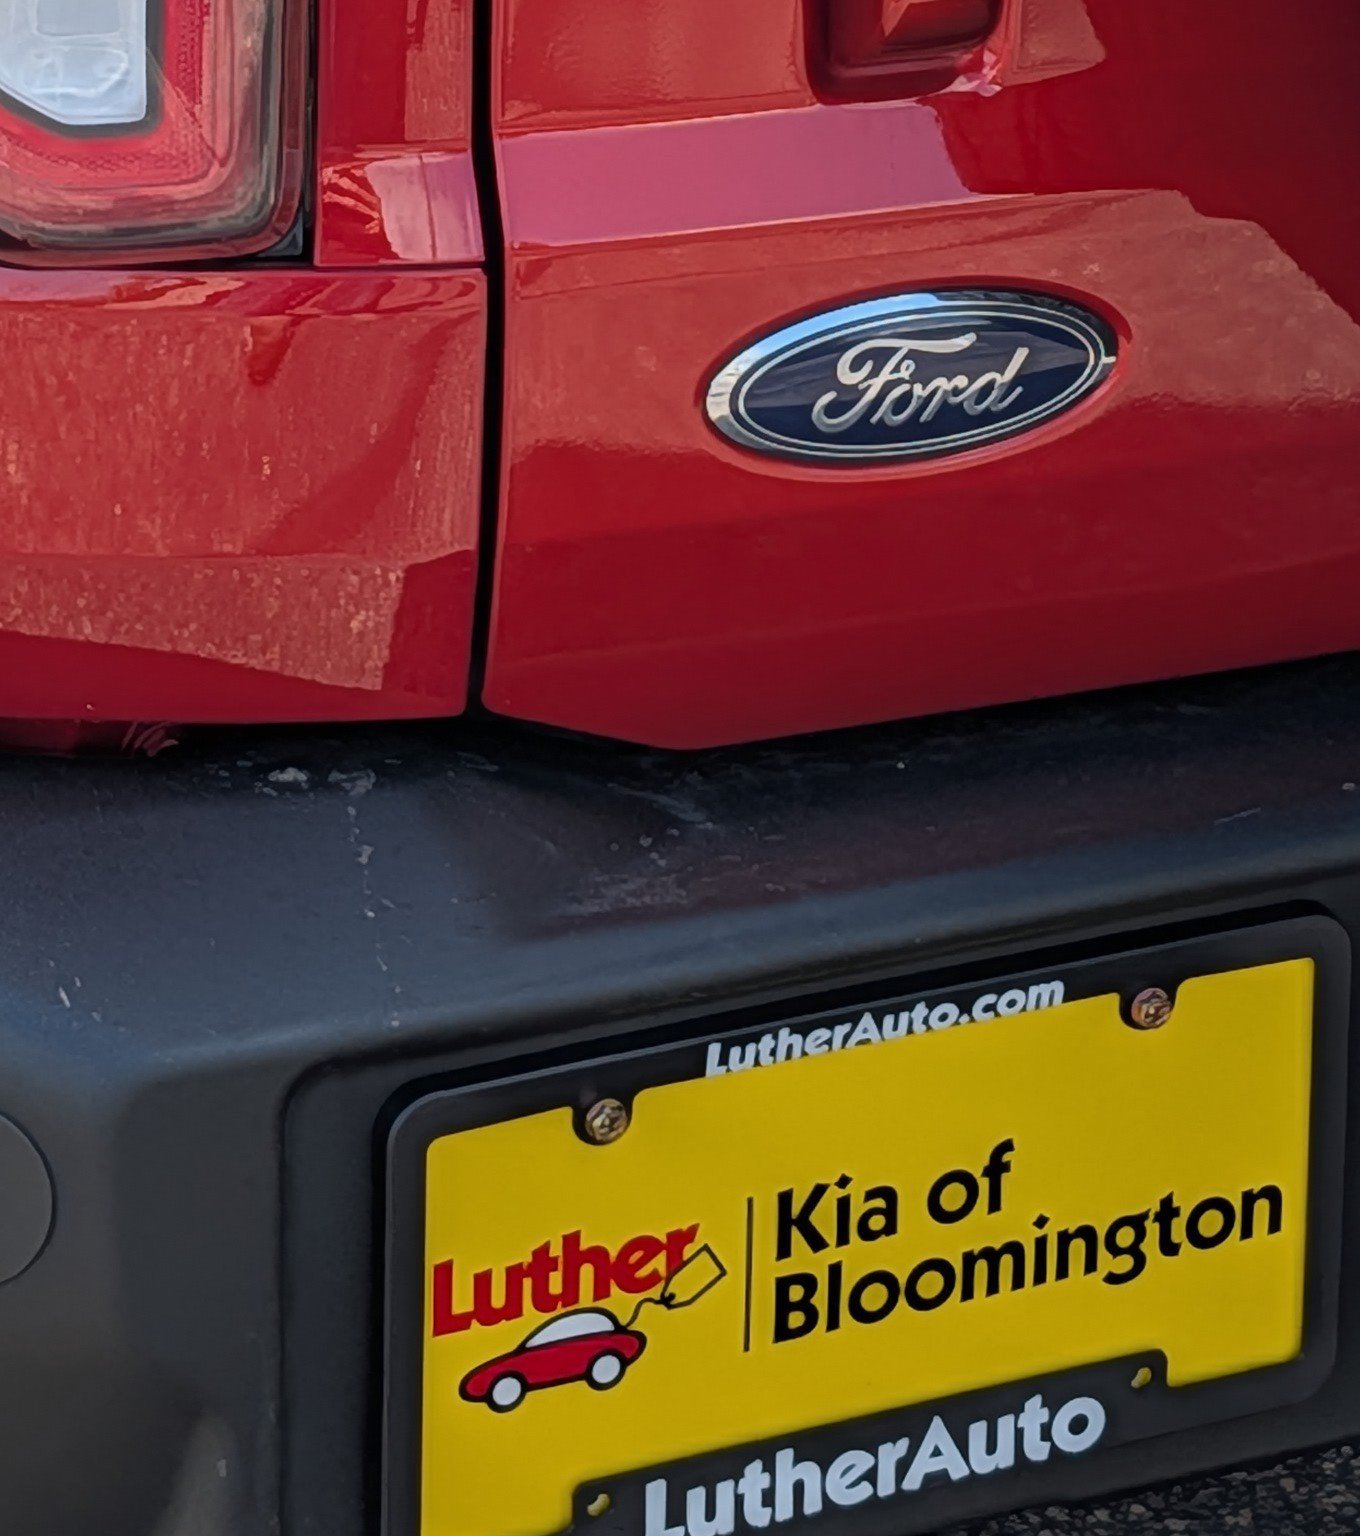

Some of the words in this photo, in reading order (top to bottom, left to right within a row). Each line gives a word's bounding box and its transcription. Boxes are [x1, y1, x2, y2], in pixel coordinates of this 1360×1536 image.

[812, 331, 1030, 433] Ford
[705, 979, 1065, 1078] LutherAuto.com
[775, 1172, 899, 1262] Kia
[926, 1137, 1016, 1225] of
[432, 1223, 701, 1338] Luther
[771, 1183, 1284, 1344] Bloomington
[645, 1393, 1107, 1536] LutherAuto
